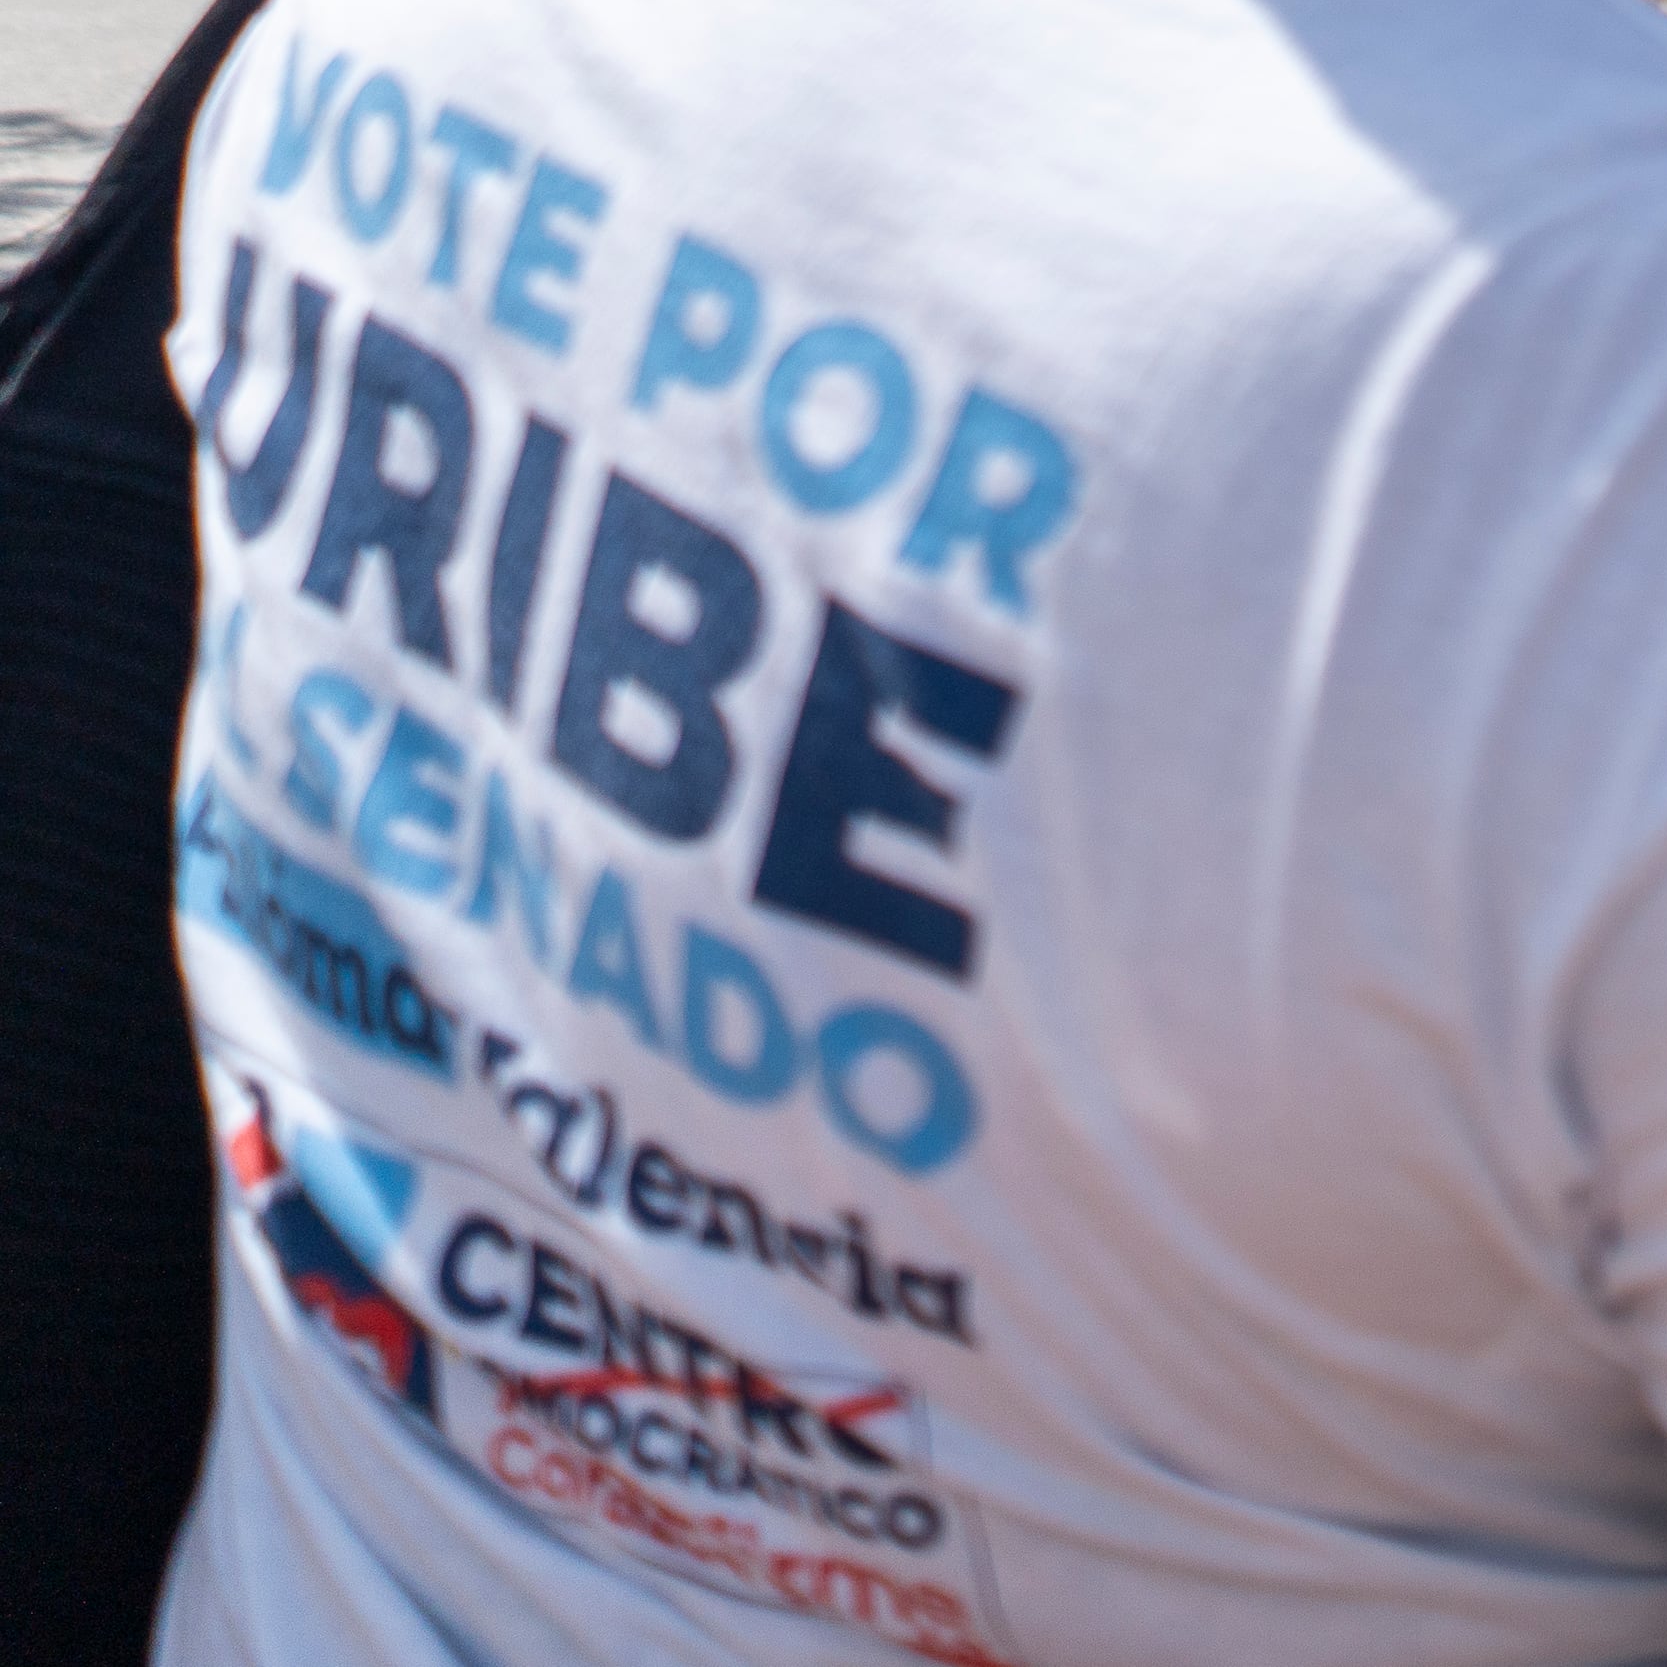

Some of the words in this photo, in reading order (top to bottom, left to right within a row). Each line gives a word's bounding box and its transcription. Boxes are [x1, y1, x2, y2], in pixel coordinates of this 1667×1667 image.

[198, 232, 1027, 982] URIBE
[256, 31, 615, 356] VOTE
[624, 228, 1085, 619] POR
[280, 664, 980, 1180] SENADO
